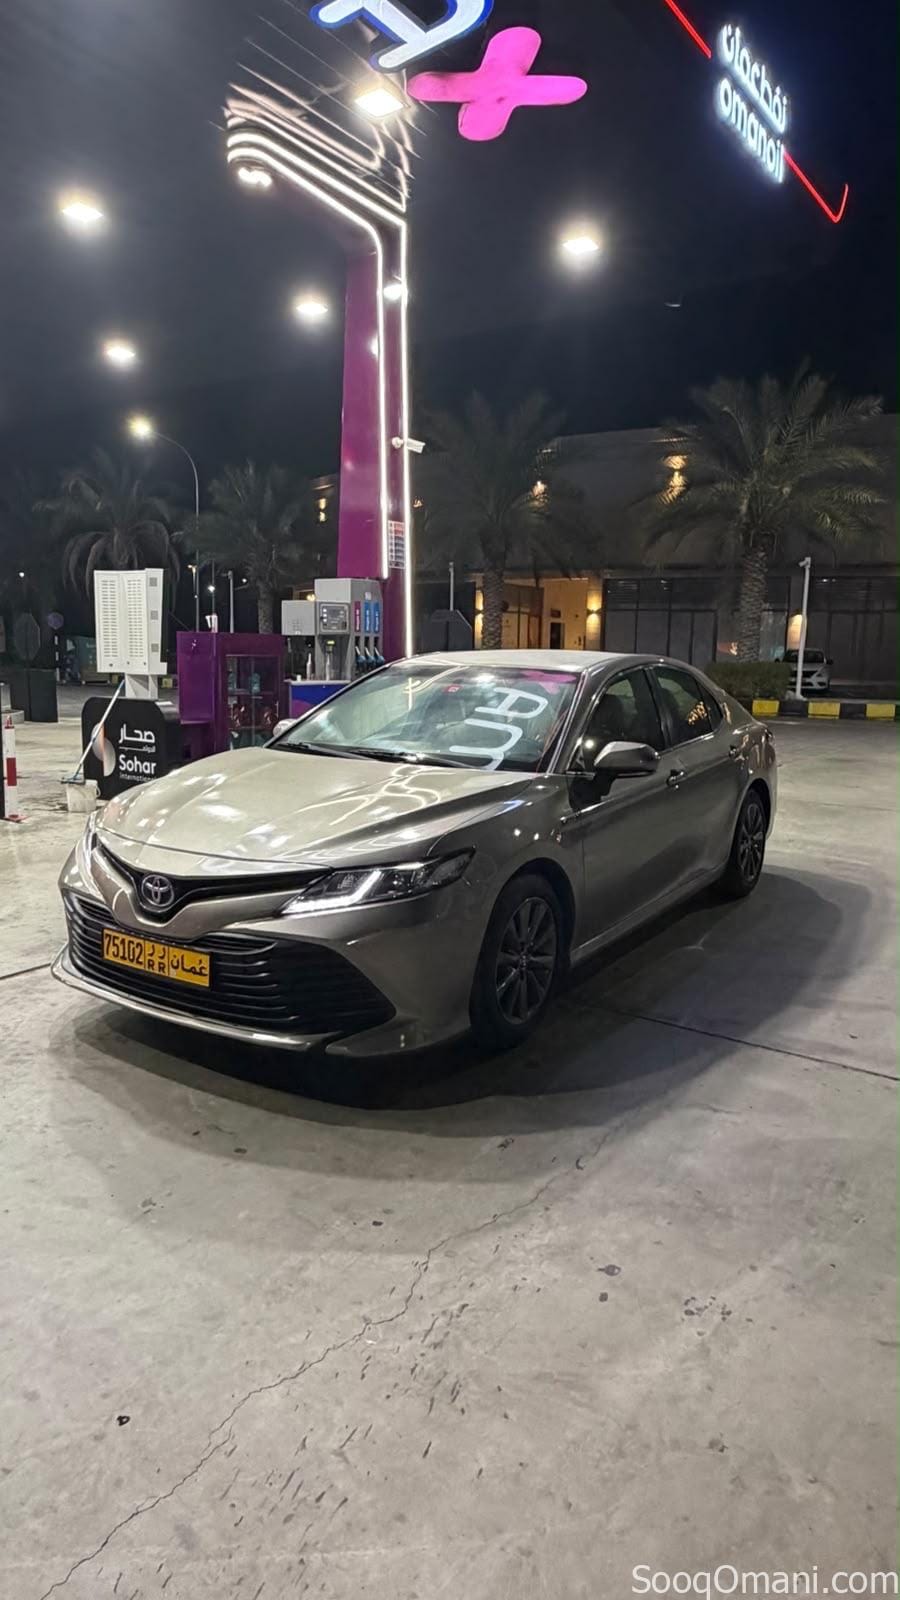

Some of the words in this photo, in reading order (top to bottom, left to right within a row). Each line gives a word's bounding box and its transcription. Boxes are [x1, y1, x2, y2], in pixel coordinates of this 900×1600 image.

[718, 77, 785, 184] omanoil
[118, 723, 156, 744] صحار
[118, 753, 157, 775] Sohar
[103, 933, 144, 966] 75102
